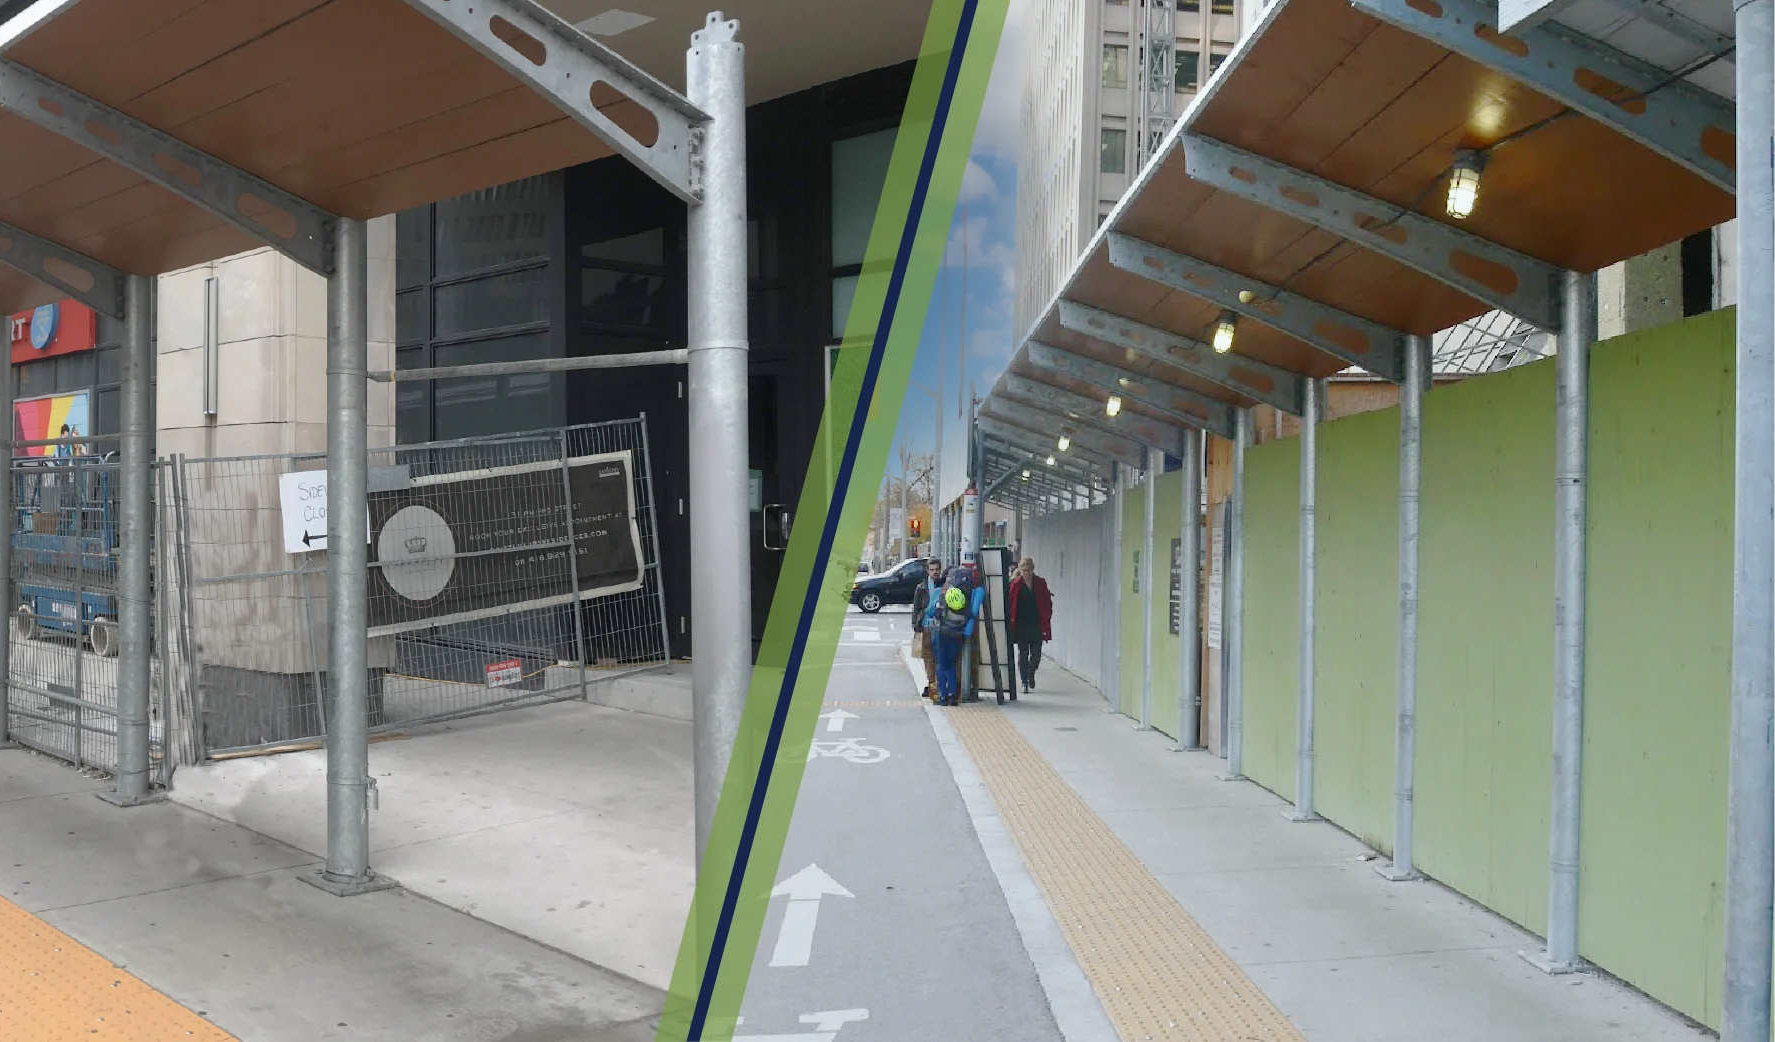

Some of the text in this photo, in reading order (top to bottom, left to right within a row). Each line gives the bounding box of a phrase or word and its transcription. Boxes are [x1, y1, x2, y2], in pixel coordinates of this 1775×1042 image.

[304, 505, 327, 521] CLO
[469, 532, 491, 541] BOOK
[493, 528, 515, 537] YOUR
[560, 513, 612, 526] AOINTMENT
